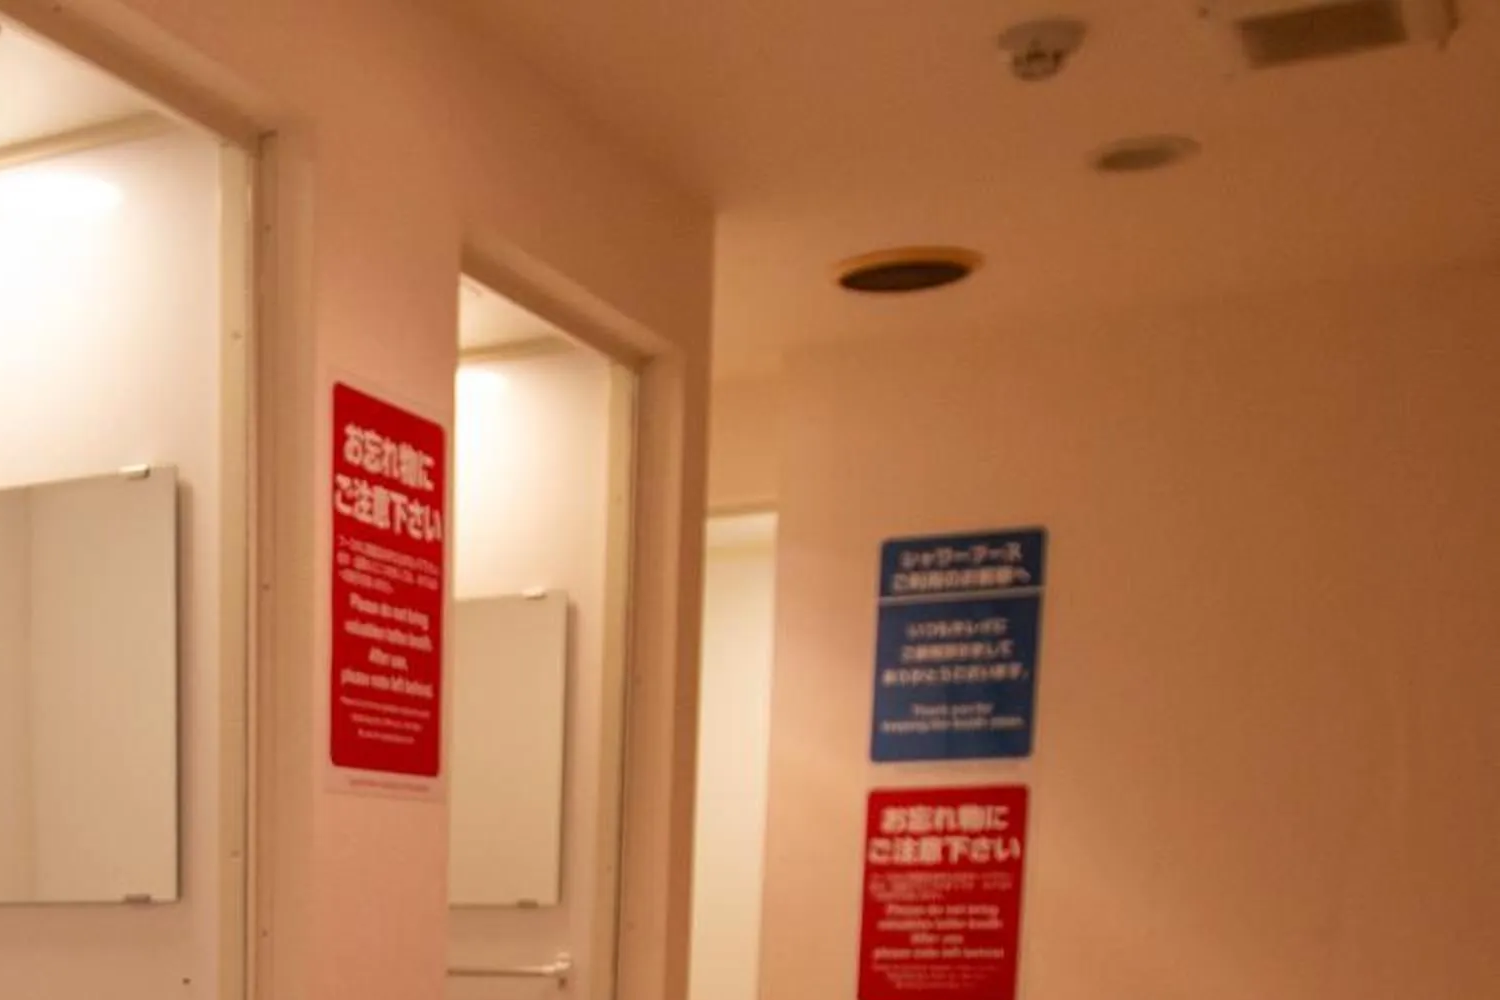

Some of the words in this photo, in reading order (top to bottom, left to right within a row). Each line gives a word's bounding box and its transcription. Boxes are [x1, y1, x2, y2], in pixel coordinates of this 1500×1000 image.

[343, 422, 435, 491] お忘れ物に
[334, 473, 443, 543] ご注意下さい
